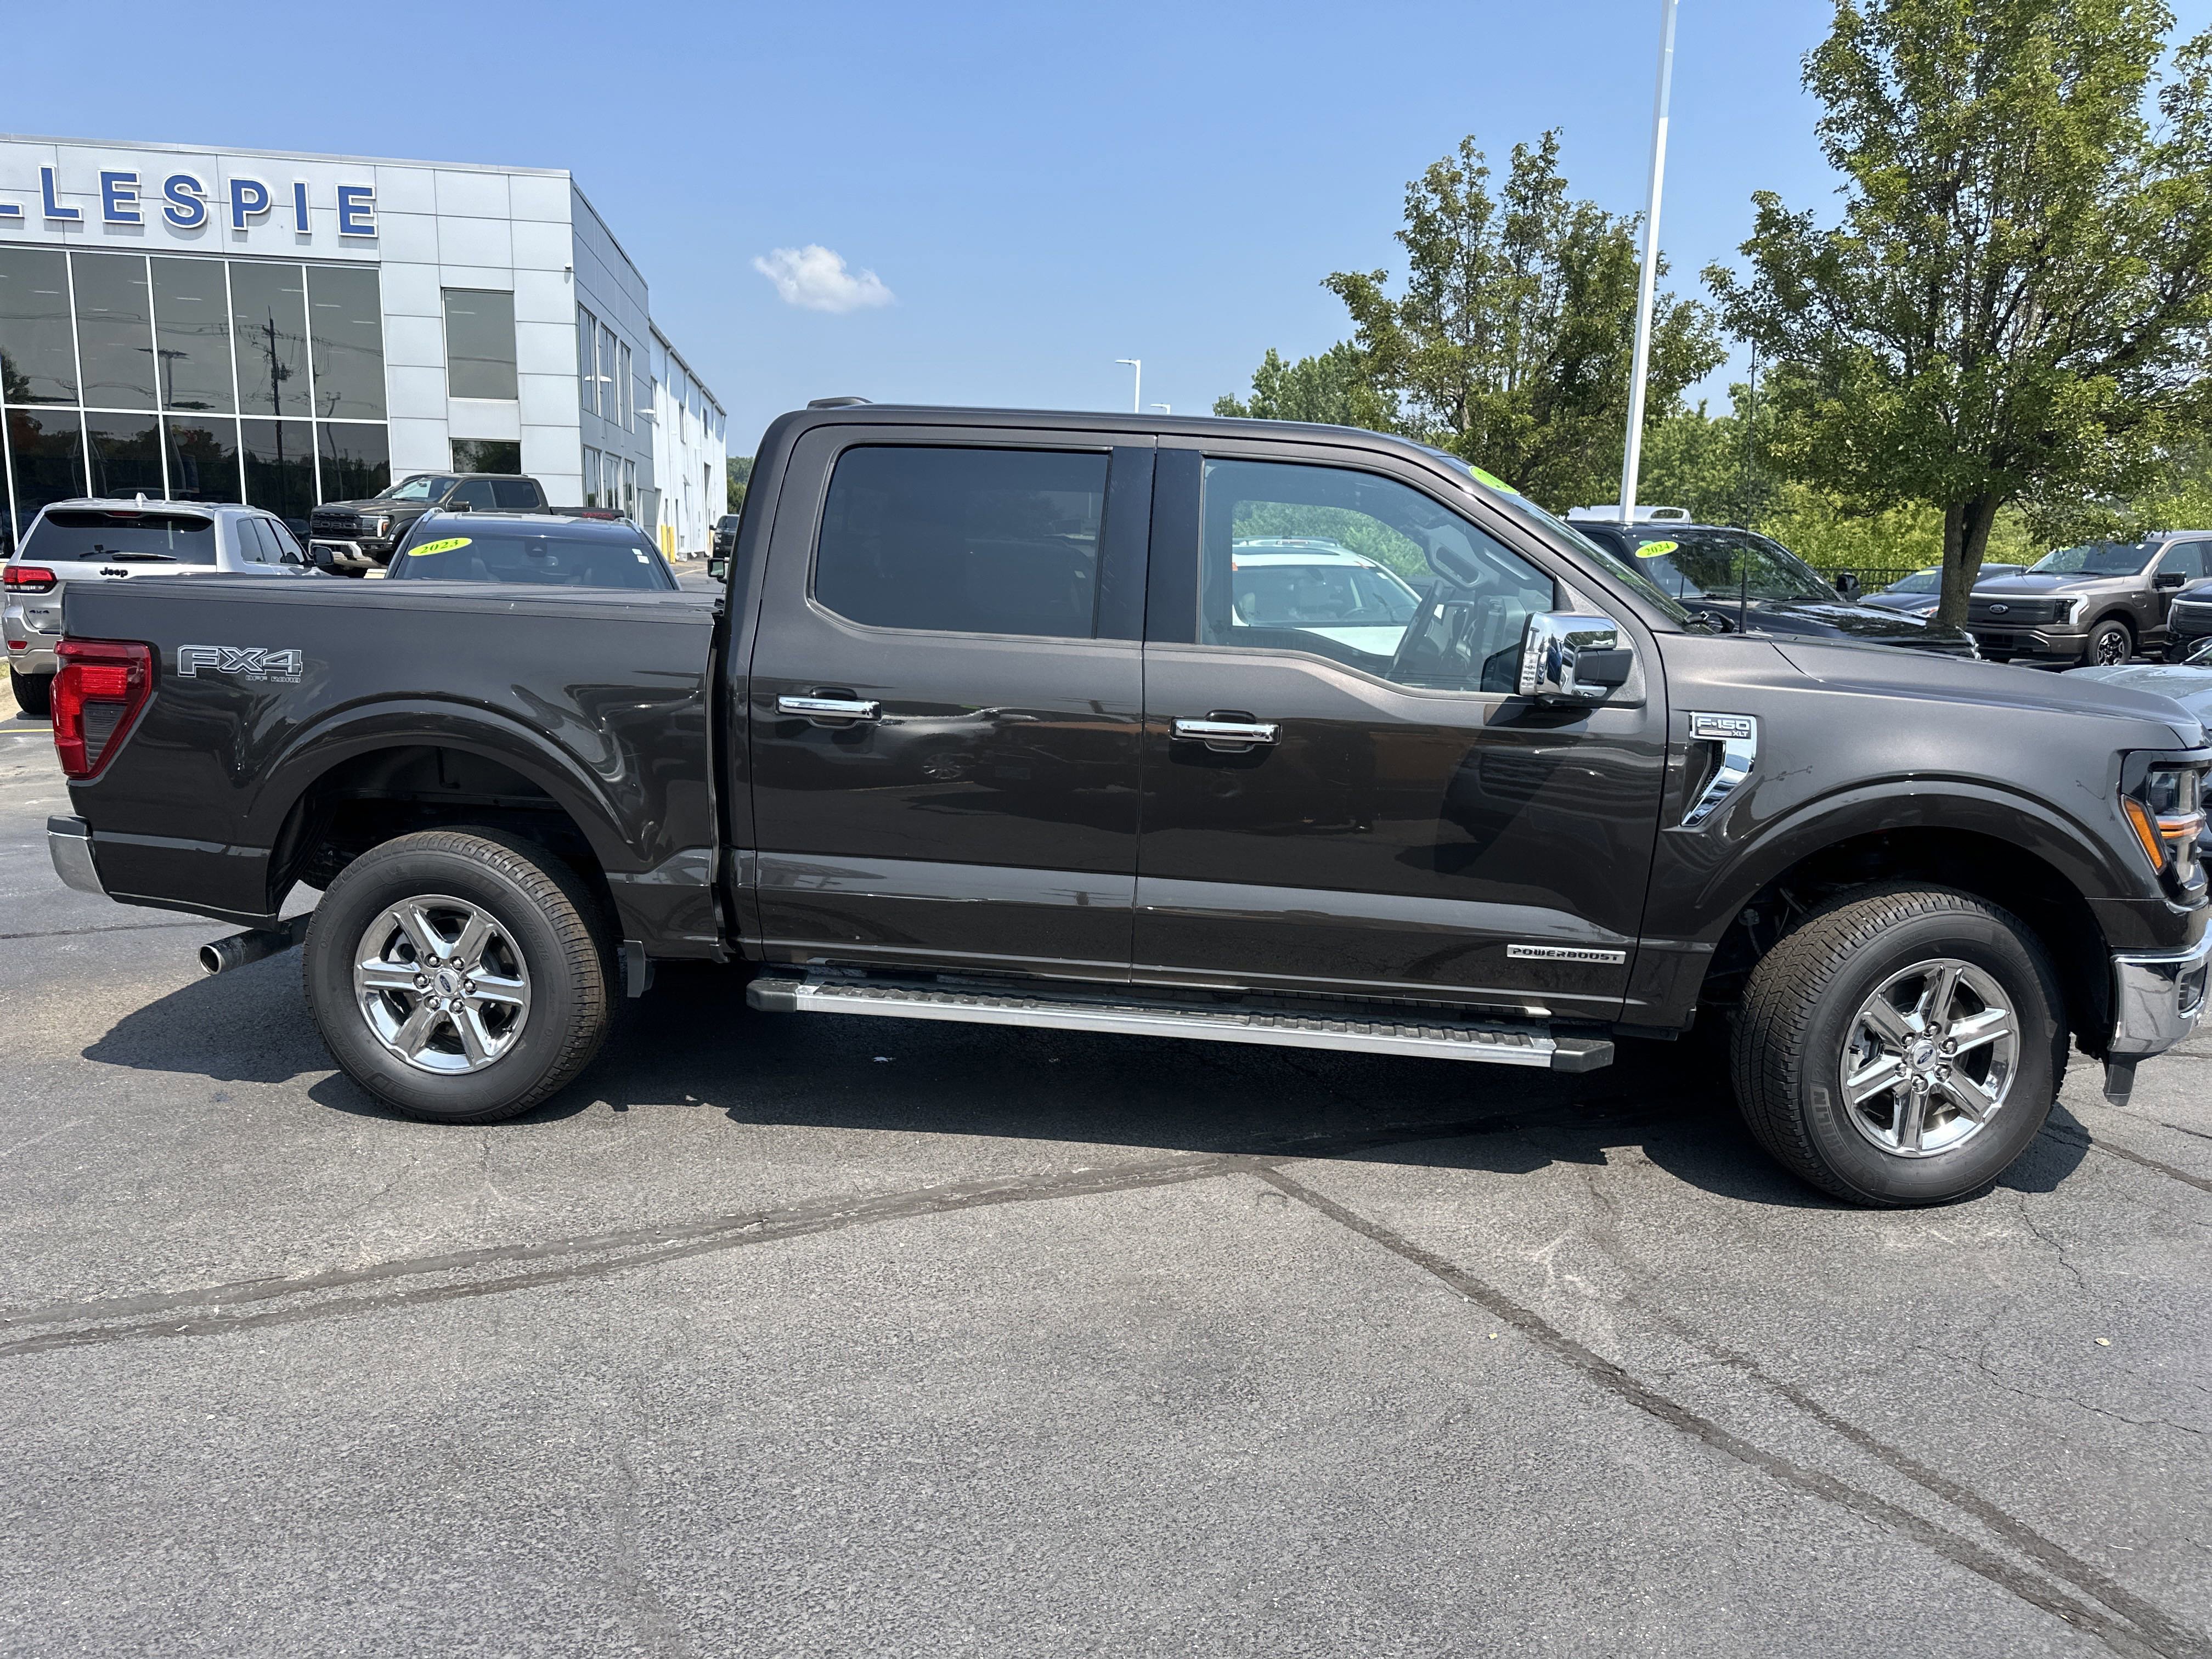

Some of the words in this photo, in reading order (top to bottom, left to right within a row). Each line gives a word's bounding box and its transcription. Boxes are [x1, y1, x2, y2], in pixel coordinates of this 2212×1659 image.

[420, 539, 459, 554] 2023
[1645, 543, 1671, 555] 2024
[99, 567, 128, 578] Jeep
[177, 644, 303, 678] FX4
[1696, 718, 1750, 730] F-150
[1513, 947, 1620, 961] POWERBOOST
